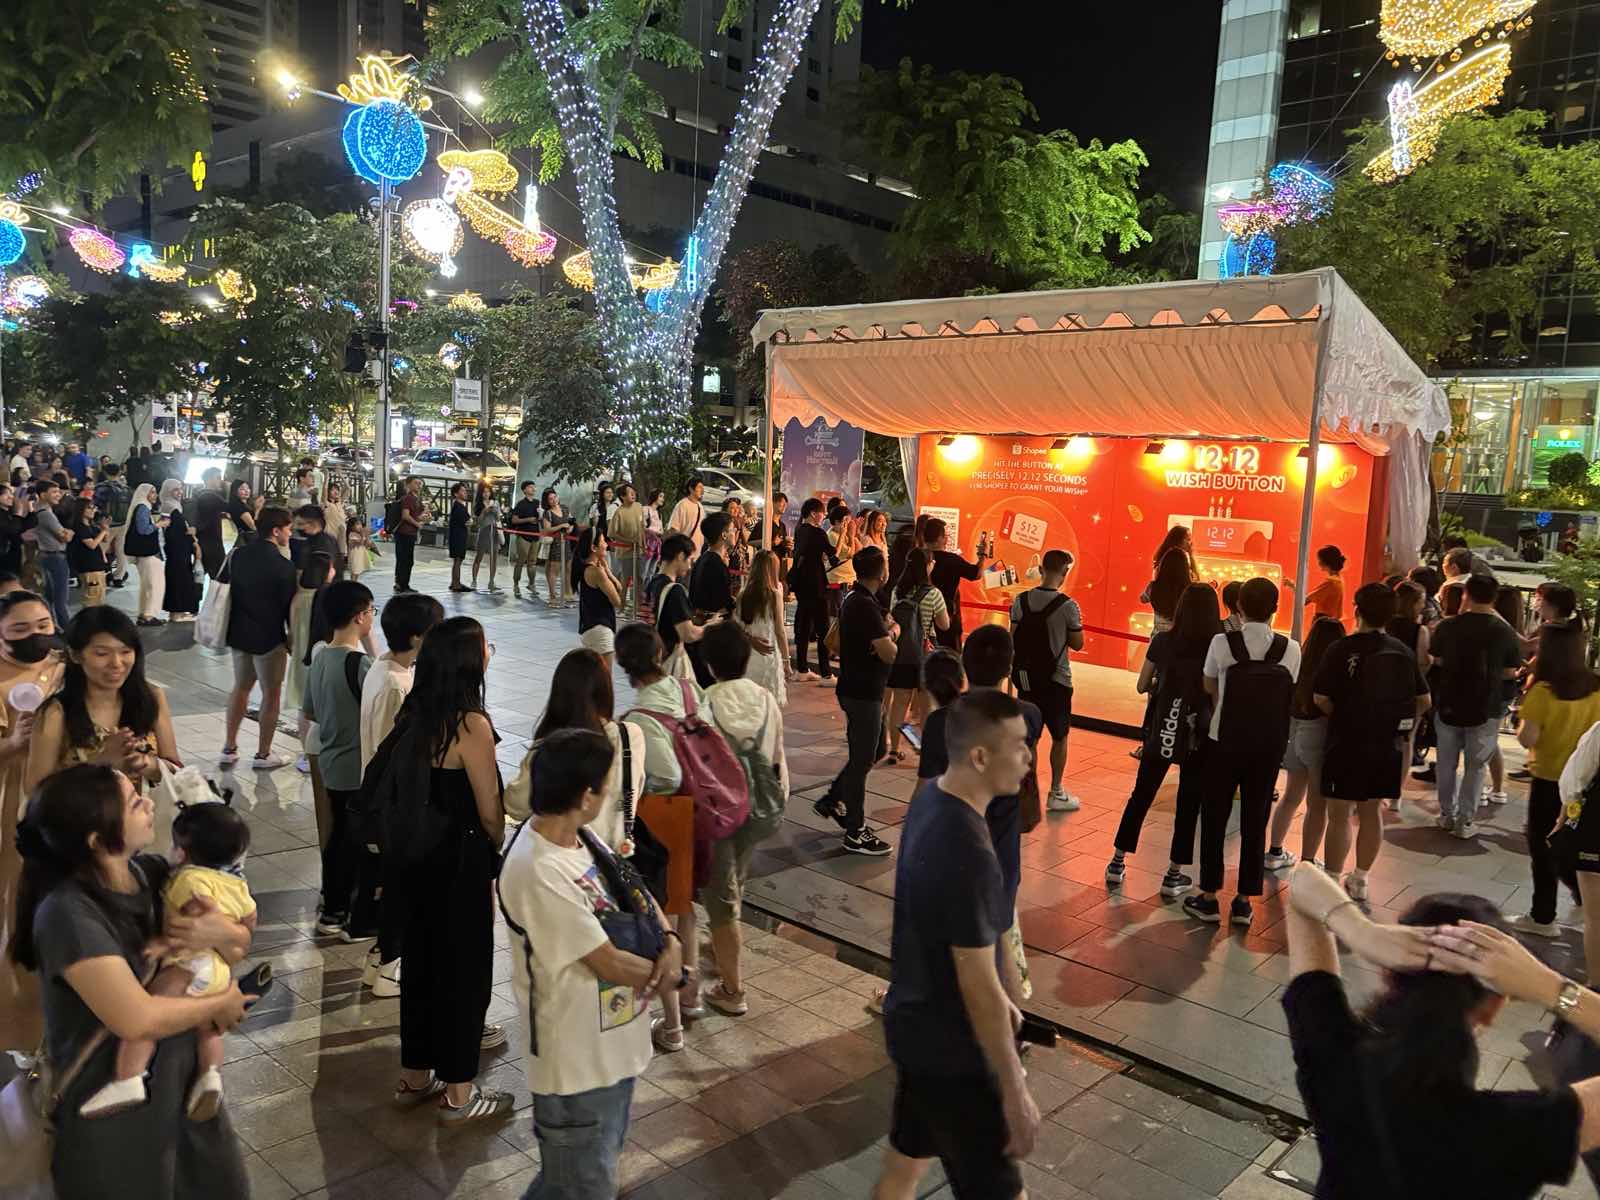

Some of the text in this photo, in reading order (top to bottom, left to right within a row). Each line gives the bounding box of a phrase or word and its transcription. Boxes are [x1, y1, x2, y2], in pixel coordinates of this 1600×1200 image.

[1022, 446, 1048, 456] Shopee
[1022, 461, 1053, 470] BUTTON
[972, 471, 1015, 481] PRECISELY
[1043, 473, 1088, 486] SECONDS
[1167, 472, 1285, 493] WISH BUTTON
[1020, 483, 1042, 491] GRANT
[1044, 485, 1063, 494] YOUR
